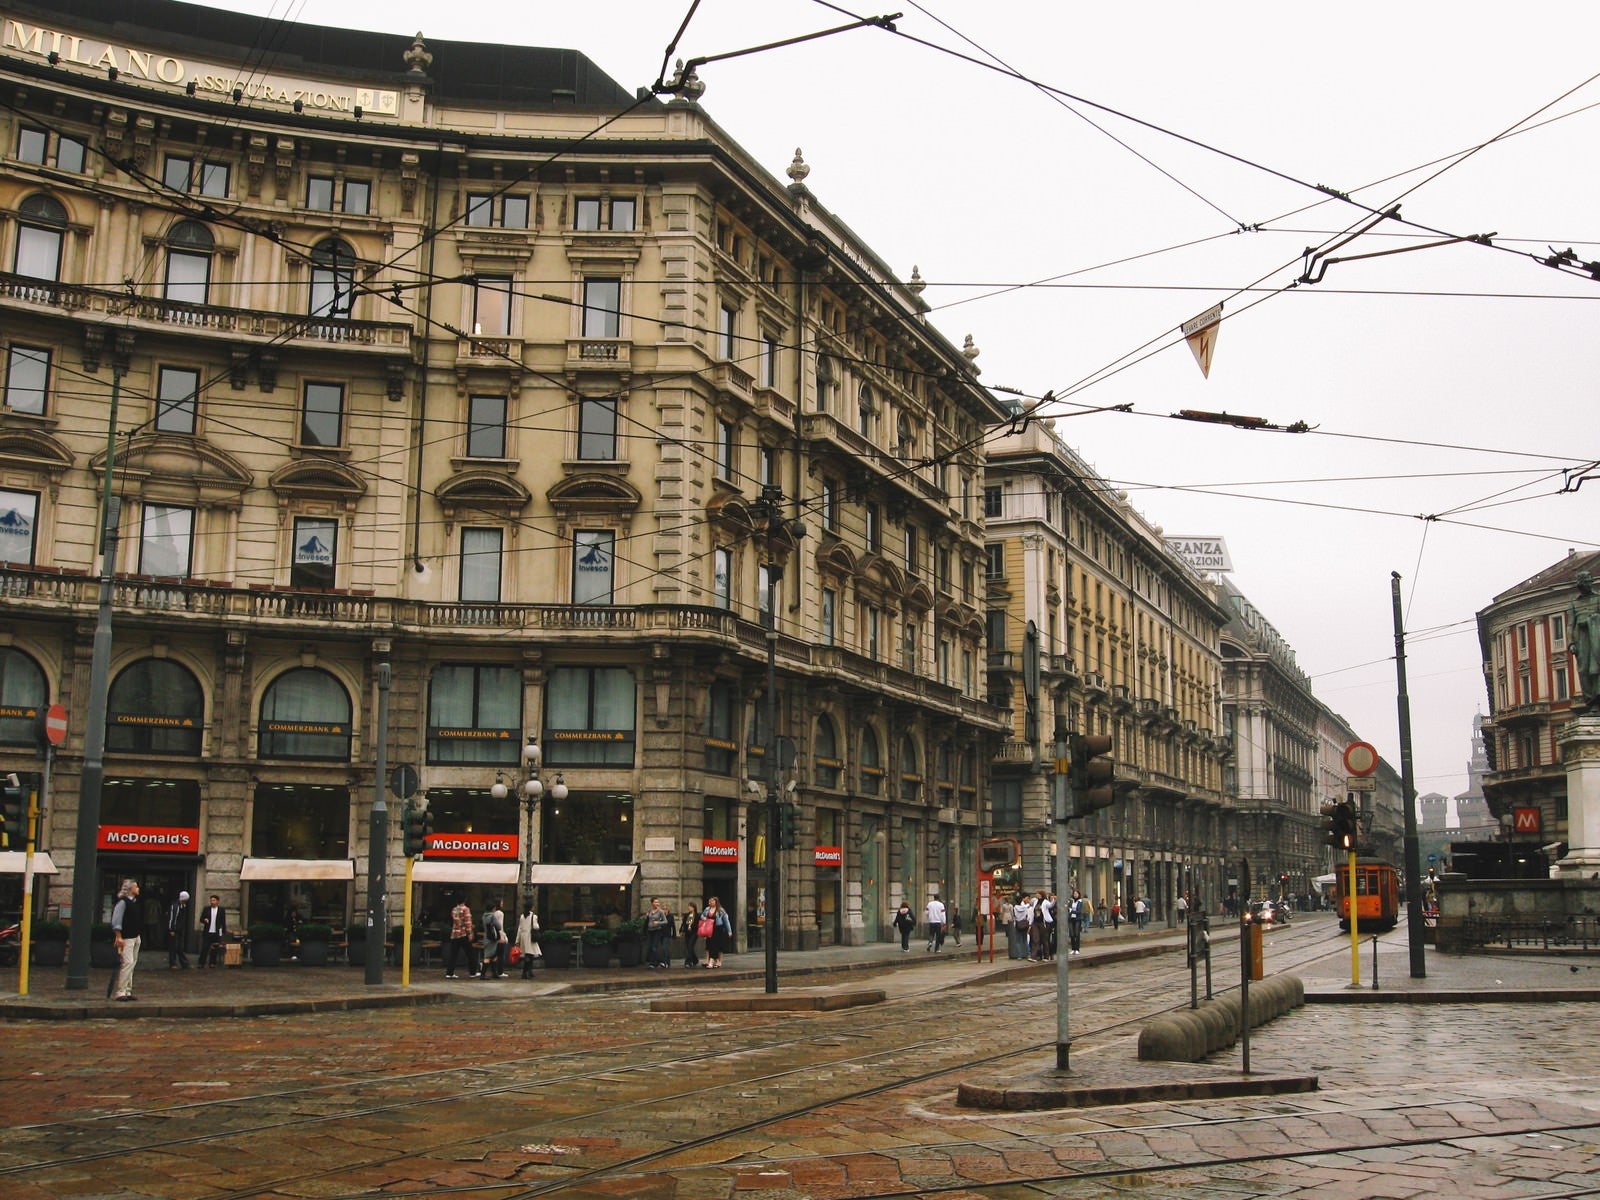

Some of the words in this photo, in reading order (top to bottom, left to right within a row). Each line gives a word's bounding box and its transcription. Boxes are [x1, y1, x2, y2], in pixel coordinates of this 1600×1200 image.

[6, 21, 185, 84] MILANO
[192, 73, 351, 111] ASSICURAZIONI
[1173, 542, 1223, 554] EANZA
[117, 715, 180, 725] COMMERZBANK
[268, 723, 328, 733] COMMERZBANK
[438, 730, 497, 738] COMMERZBANK
[553, 732, 612, 740] COMMERZBANK
[1517, 813, 1537, 828] M
[107, 832, 190, 845] McDonald's
[432, 839, 510, 851] McDonald's
[704, 845, 737, 857] McDonald's
[815, 851, 841, 860] McDonald's
